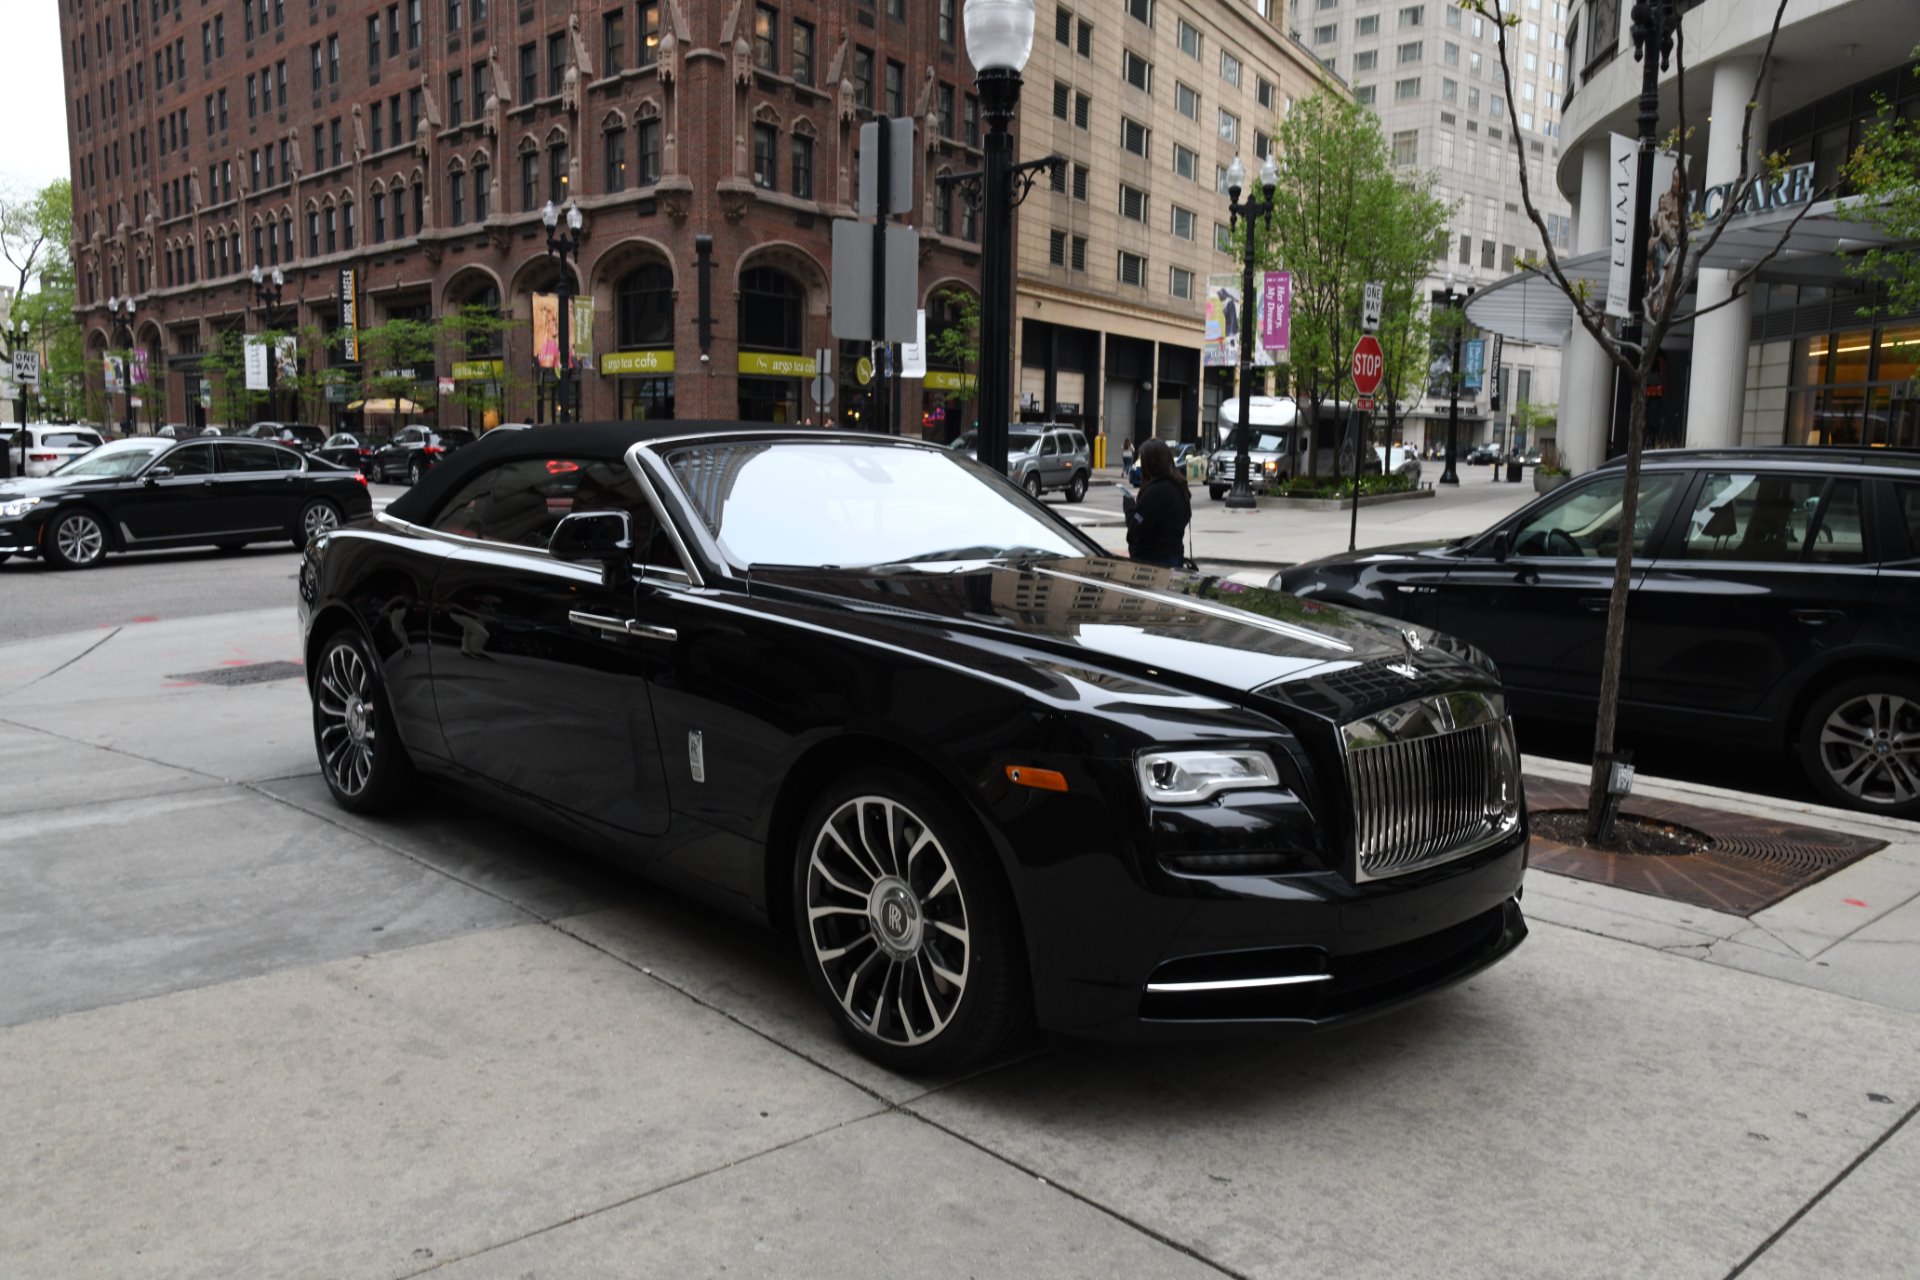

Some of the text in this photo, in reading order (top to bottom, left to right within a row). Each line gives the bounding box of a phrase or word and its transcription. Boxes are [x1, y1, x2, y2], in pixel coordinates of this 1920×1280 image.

[342, 269, 353, 300] BAGELS
[1266, 286, 1275, 301] My
[1276, 286, 1286, 302] Her
[1366, 286, 1381, 300] ONE
[1365, 302, 1380, 313] WAY
[15, 353, 35, 362] ONE
[634, 352, 658, 369] café
[1354, 353, 1381, 377] STOP
[15, 362, 36, 371] WAY
[772, 360, 793, 375] argo
